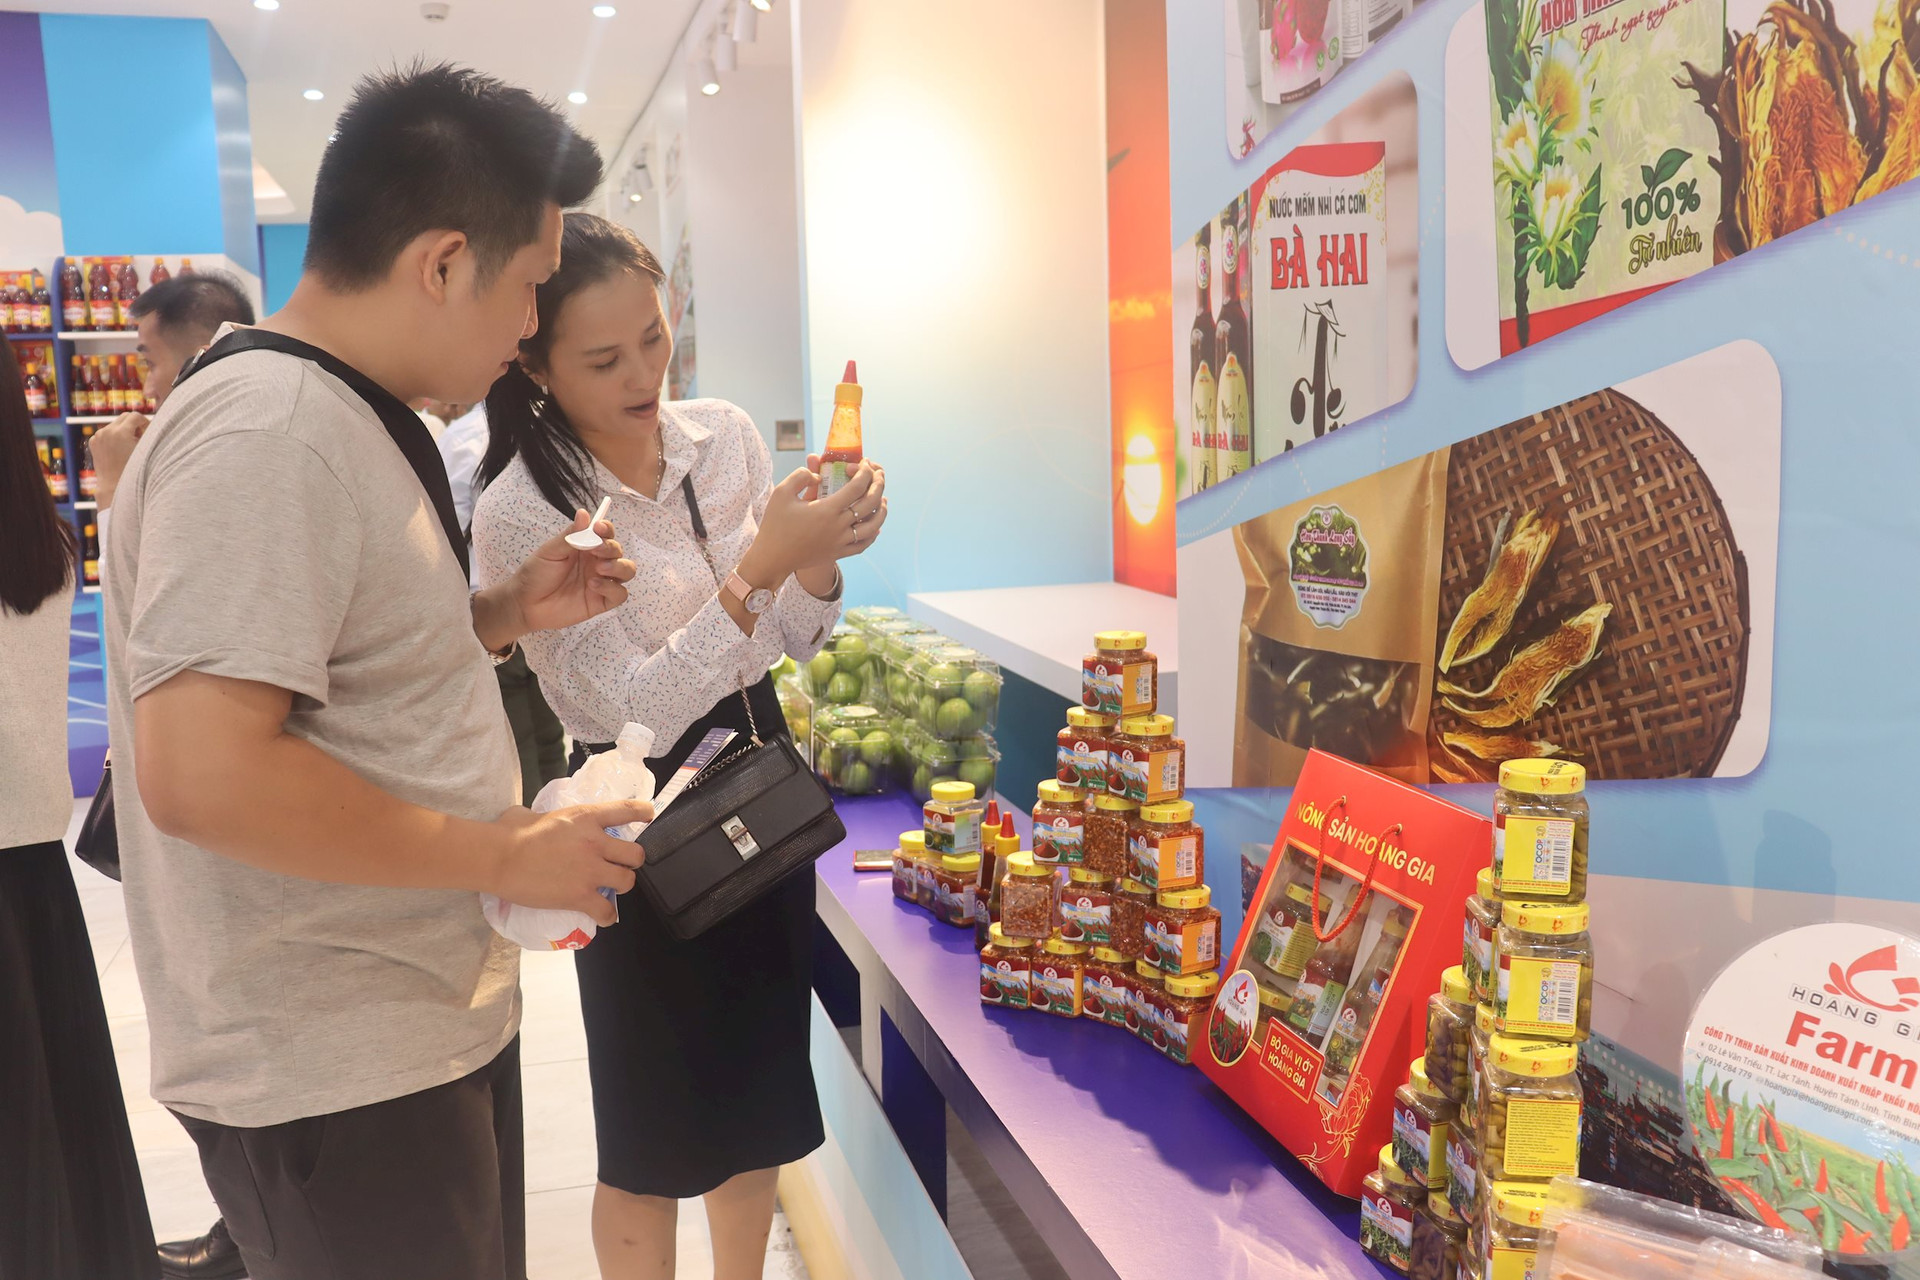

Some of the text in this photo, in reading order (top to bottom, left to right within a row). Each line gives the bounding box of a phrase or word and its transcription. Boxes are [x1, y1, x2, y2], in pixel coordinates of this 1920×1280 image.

[1335, 188, 1346, 215] CÁ
[1621, 178, 1701, 230] 100%
[1656, 213, 1702, 261] nhiên
[1270, 224, 1368, 290] BÀ HAI
[1328, 815, 1357, 845] SẢN
[1407, 856, 1436, 886] GIA
[1535, 839, 1544, 864] OCOP
[1540, 980, 1549, 1005] OCOP
[1792, 986, 1878, 1025] HOANG
[1270, 1035, 1315, 1075] BỘ GIA VỊ ỚT
[1704, 1026, 1724, 1040] CÔNG
[1724, 1033, 1734, 1044] TY
[1734, 1037, 1754, 1051] TNHH
[1754, 1044, 1770, 1057] SẢN
[1790, 1058, 1810, 1073] KINH
[1810, 1065, 1837, 1082] DOANH
[1704, 1056, 1721, 1068] 0914
[1722, 1063, 1737, 1074] 284
[1737, 1069, 1753, 1080] 779
[1708, 1043, 1718, 1053] 02
[1718, 1047, 1727, 1056] Lê
[1785, 1010, 1918, 1090] Farm
[1268, 1051, 1306, 1090] HOÀNG GIA
